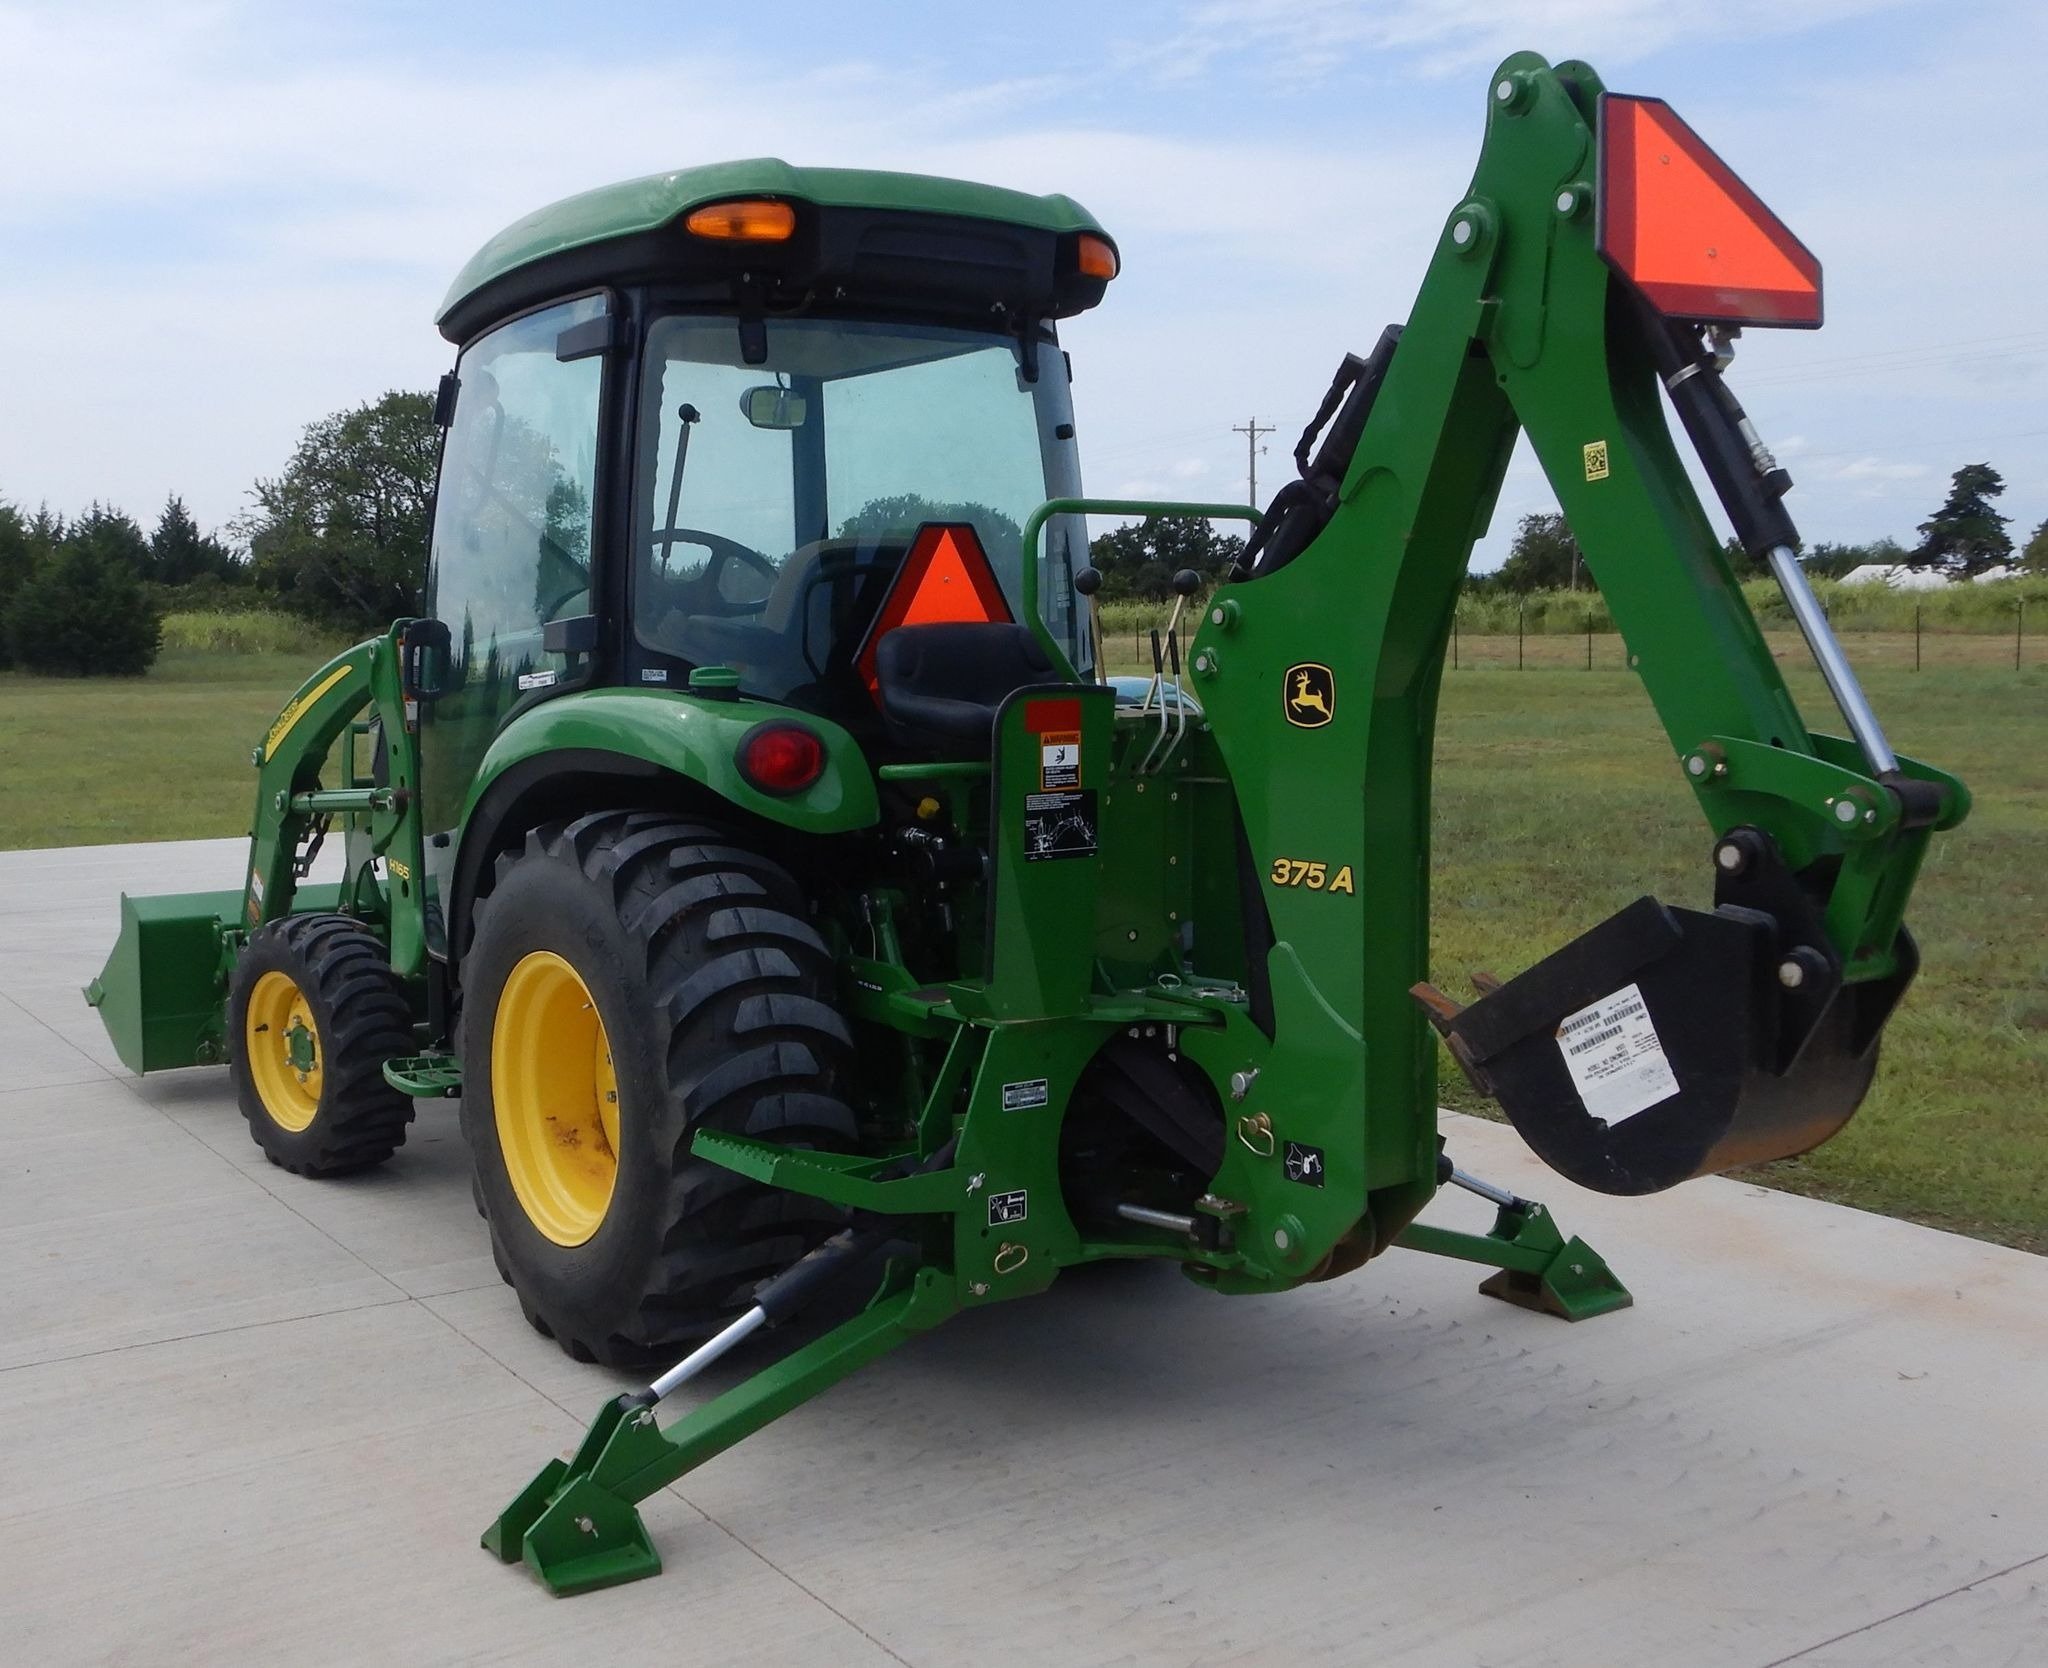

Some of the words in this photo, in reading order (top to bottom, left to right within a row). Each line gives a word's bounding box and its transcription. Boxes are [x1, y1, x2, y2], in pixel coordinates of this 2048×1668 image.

[389, 858, 410, 880] H165
[1271, 857, 1327, 889] 375
[1328, 865, 1355, 894] A
